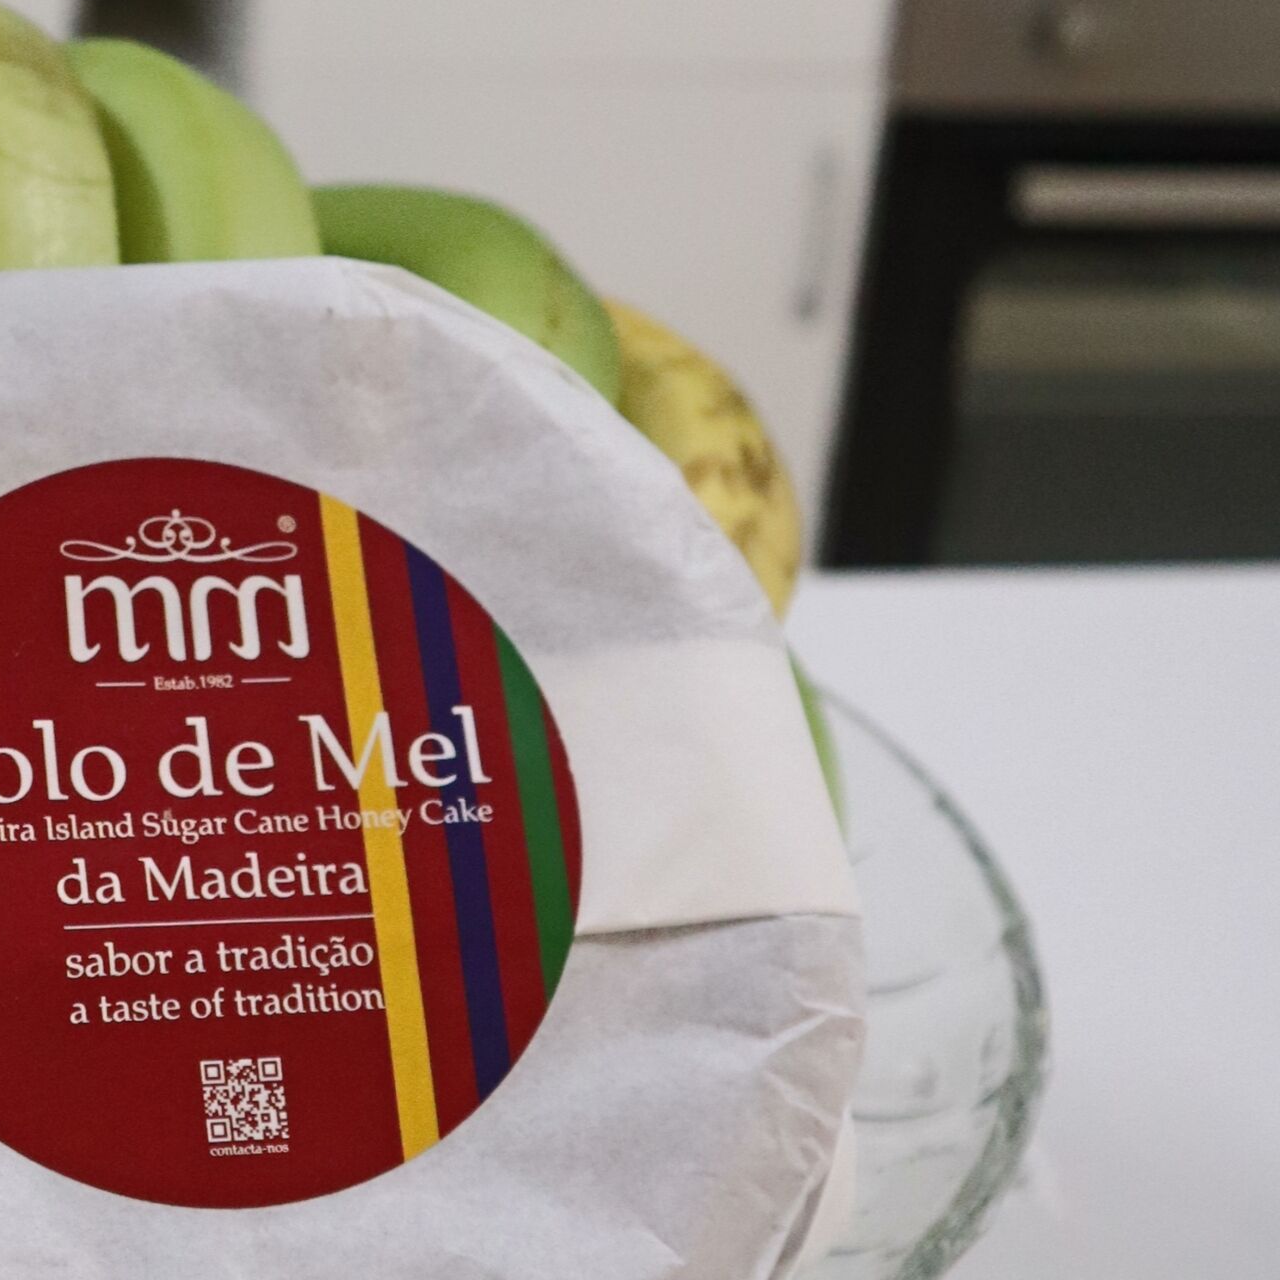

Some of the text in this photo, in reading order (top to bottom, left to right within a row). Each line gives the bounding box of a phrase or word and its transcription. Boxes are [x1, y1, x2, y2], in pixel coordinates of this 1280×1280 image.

[157, 716, 276, 798] de
[298, 705, 493, 794] Mel
[45, 810, 136, 842] Island
[142, 812, 227, 848] Sugar
[233, 810, 310, 834] Cane
[316, 805, 412, 837] Honey
[419, 799, 494, 825] Cake
[56, 851, 370, 906] da Madeira
[65, 934, 375, 980] sabor a tradição
[69, 982, 386, 1025] a taste of tradition
[209, 1143, 289, 1157] contacta-nos
